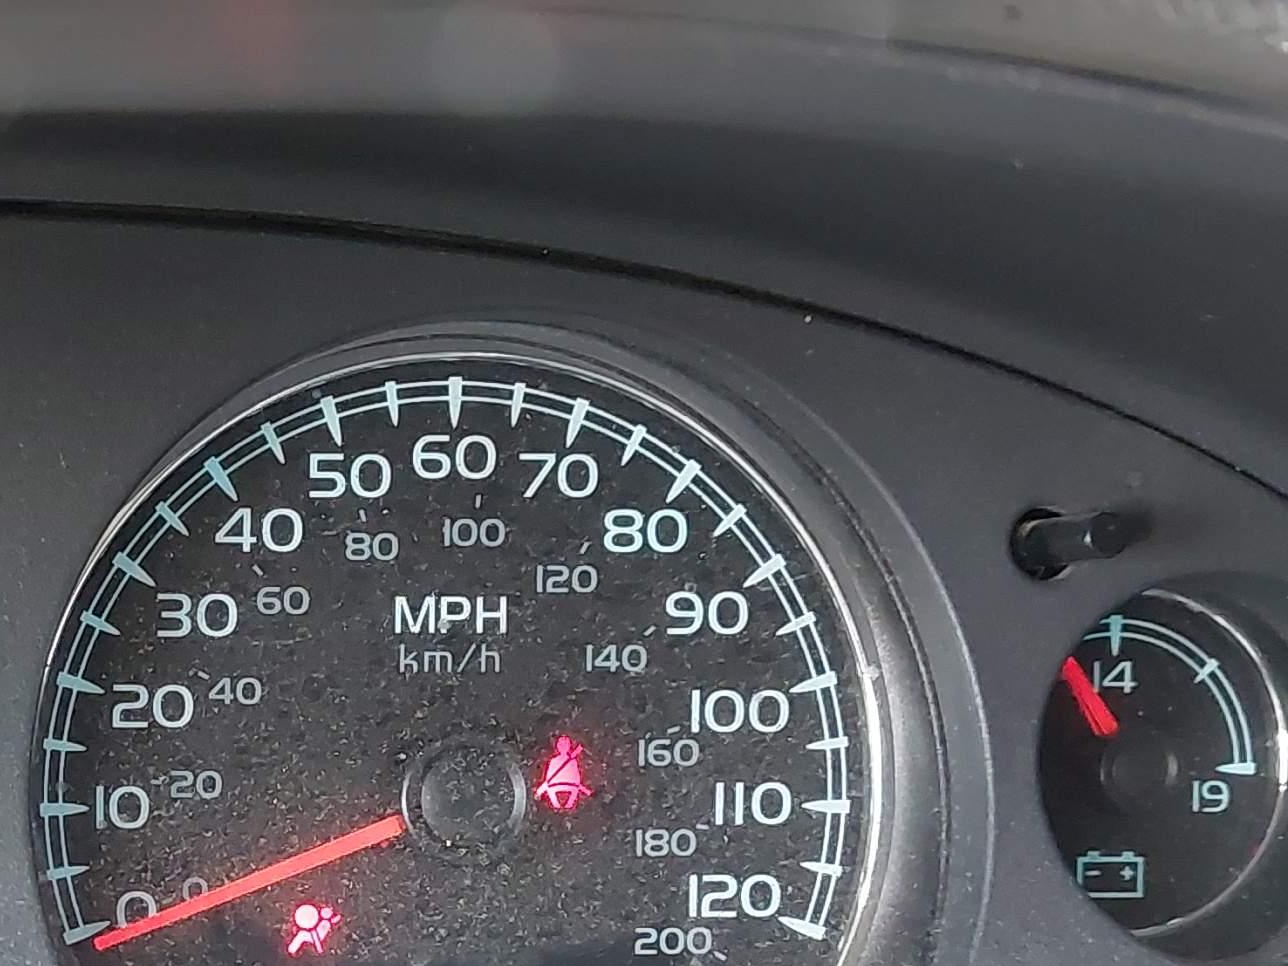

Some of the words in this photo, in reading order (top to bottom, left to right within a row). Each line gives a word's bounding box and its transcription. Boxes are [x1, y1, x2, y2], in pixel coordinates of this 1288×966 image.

[412, 435, 496, 479] 60
[309, 453, 391, 498] 50
[519, 453, 598, 498] 70
[214, 508, 303, 552] 40
[345, 532, 399, 561] 80
[443, 518, 505, 547] 100
[604, 509, 688, 552] 80
[536, 565, 597, 593] 120
[156, 593, 238, 637] 30
[256, 586, 310, 615] 60
[394, 596, 507, 634] MPH
[666, 591, 748, 634] 90
[399, 644, 500, 673] km/h
[585, 645, 647, 672] 140
[208, 678, 262, 704] 40
[1093, 661, 1138, 693] 14
[112, 684, 194, 728] 20
[691, 690, 789, 733] 100
[638, 739, 700, 767] 160
[170, 770, 223, 799] 20
[1192, 780, 1230, 812] 19
[96, 786, 150, 829] 10
[715, 782, 791, 825] 110
[635, 829, 697, 857] 180
[689, 874, 781, 918] 120
[634, 927, 712, 955] 200
